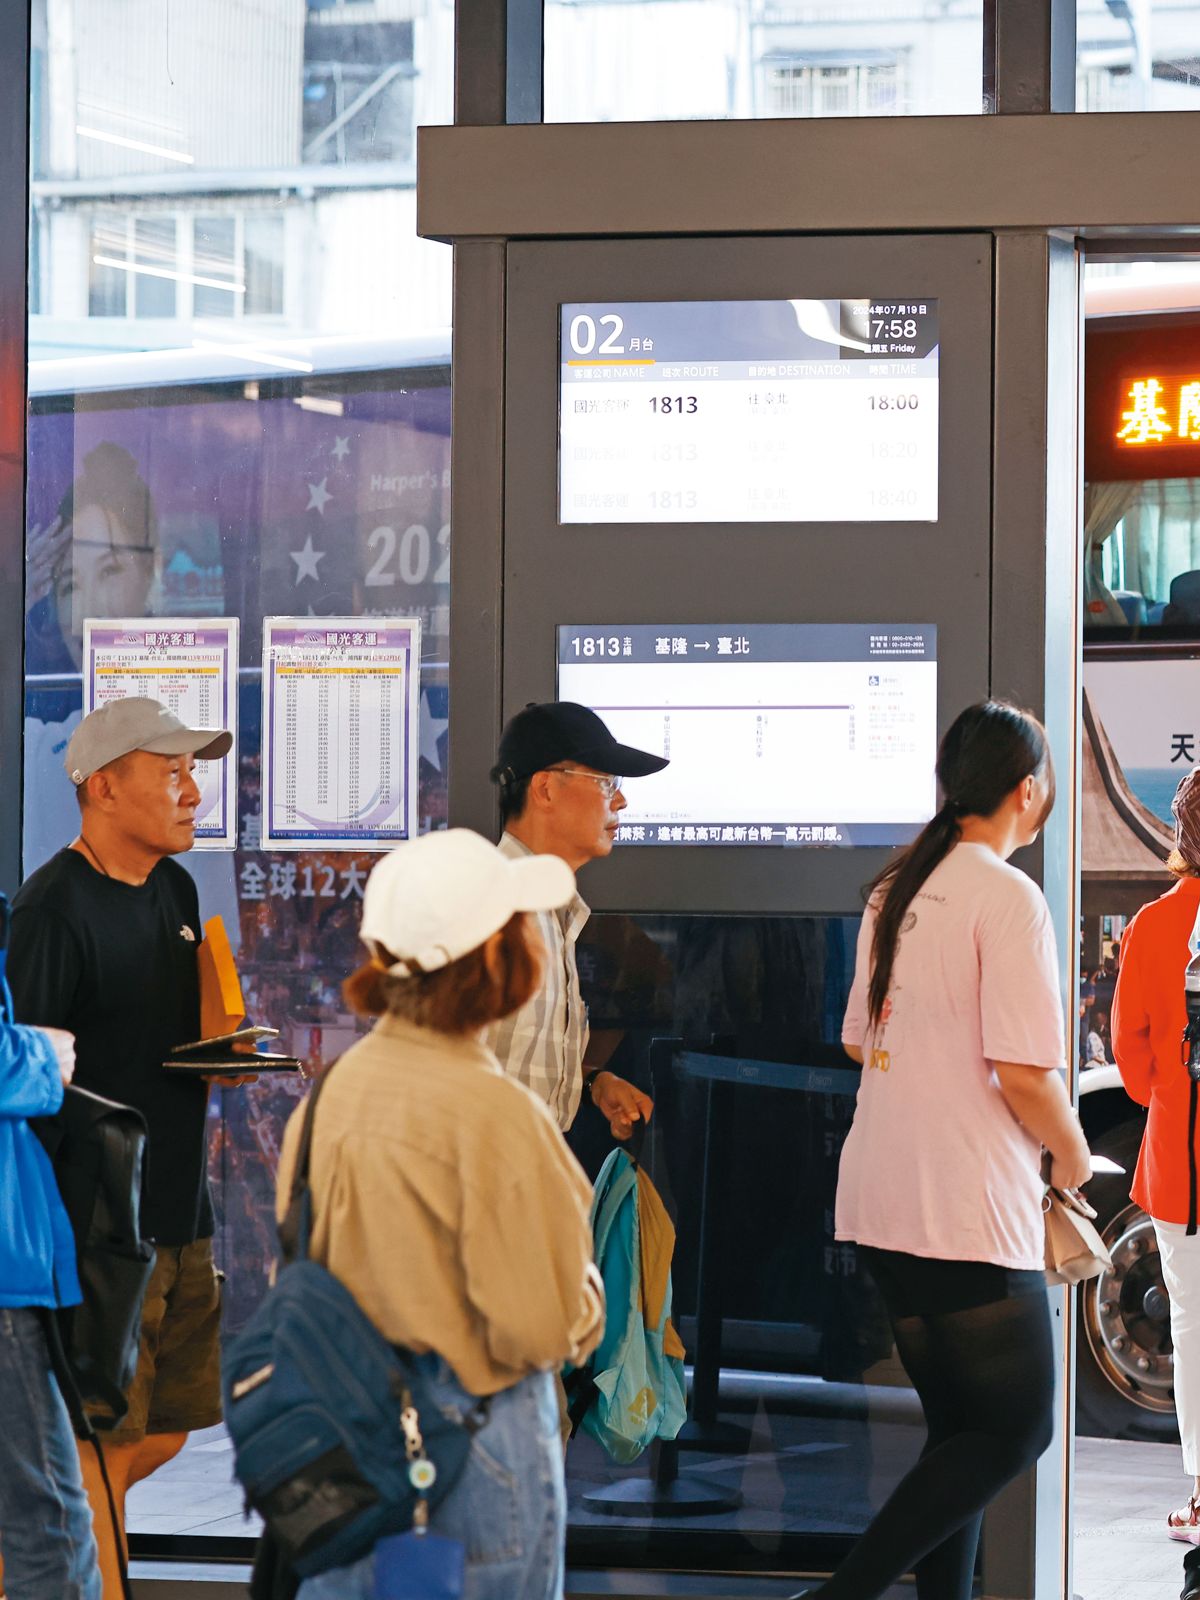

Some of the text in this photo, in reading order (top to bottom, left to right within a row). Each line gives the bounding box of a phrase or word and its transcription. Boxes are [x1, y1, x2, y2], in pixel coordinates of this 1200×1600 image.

[570, 314, 654, 355] 02 月台
[864, 319, 918, 338] 17:58
[890, 344, 917, 353] Friday
[613, 367, 646, 377] NAME
[683, 366, 720, 377] ROUTE
[779, 365, 851, 376] DESTINATION
[889, 363, 917, 374] TIME
[648, 396, 698, 414] 1813
[867, 394, 919, 411] 18:00
[371, 471, 437, 496] Harper's
[648, 490, 698, 509] 1813
[144, 632, 196, 647] 國光客運
[326, 632, 378, 647] 國光客運
[572, 637, 620, 656] 1813
[655, 637, 688, 655] 基隆
[717, 637, 750, 655] 臺北
[240, 861, 368, 900] 全球12大
